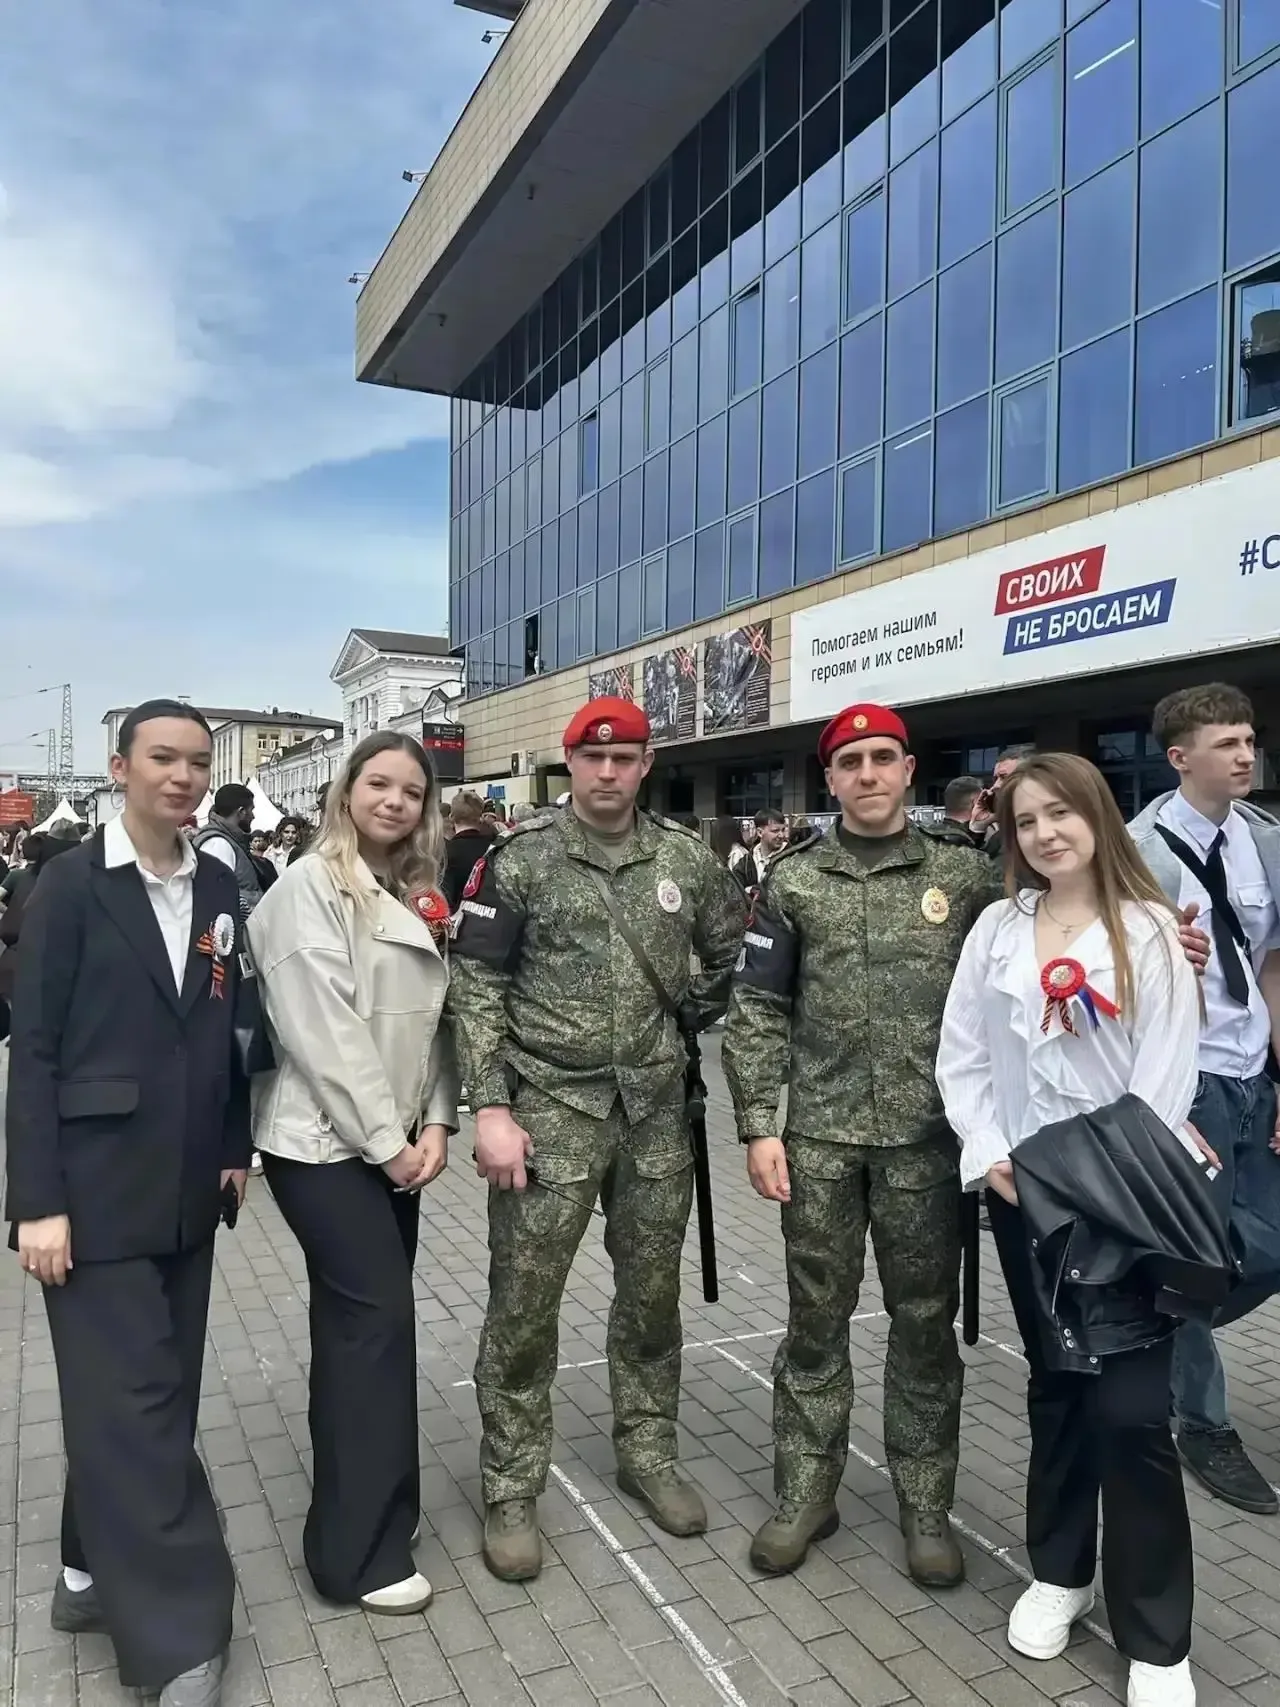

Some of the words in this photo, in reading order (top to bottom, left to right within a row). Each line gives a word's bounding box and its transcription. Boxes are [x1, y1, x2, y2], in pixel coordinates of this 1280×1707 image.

[1005, 558, 1088, 605] СВОИХ
[811, 626, 878, 657] Помогаем
[883, 611, 937, 639] нашим
[1013, 617, 1043, 647] НЕ
[1047, 590, 1162, 641] БРОСАЕМ
[811, 659, 857, 684] героям
[861, 656, 871, 671] и
[875, 650, 893, 667] их
[897, 628, 964, 662] семьям!
